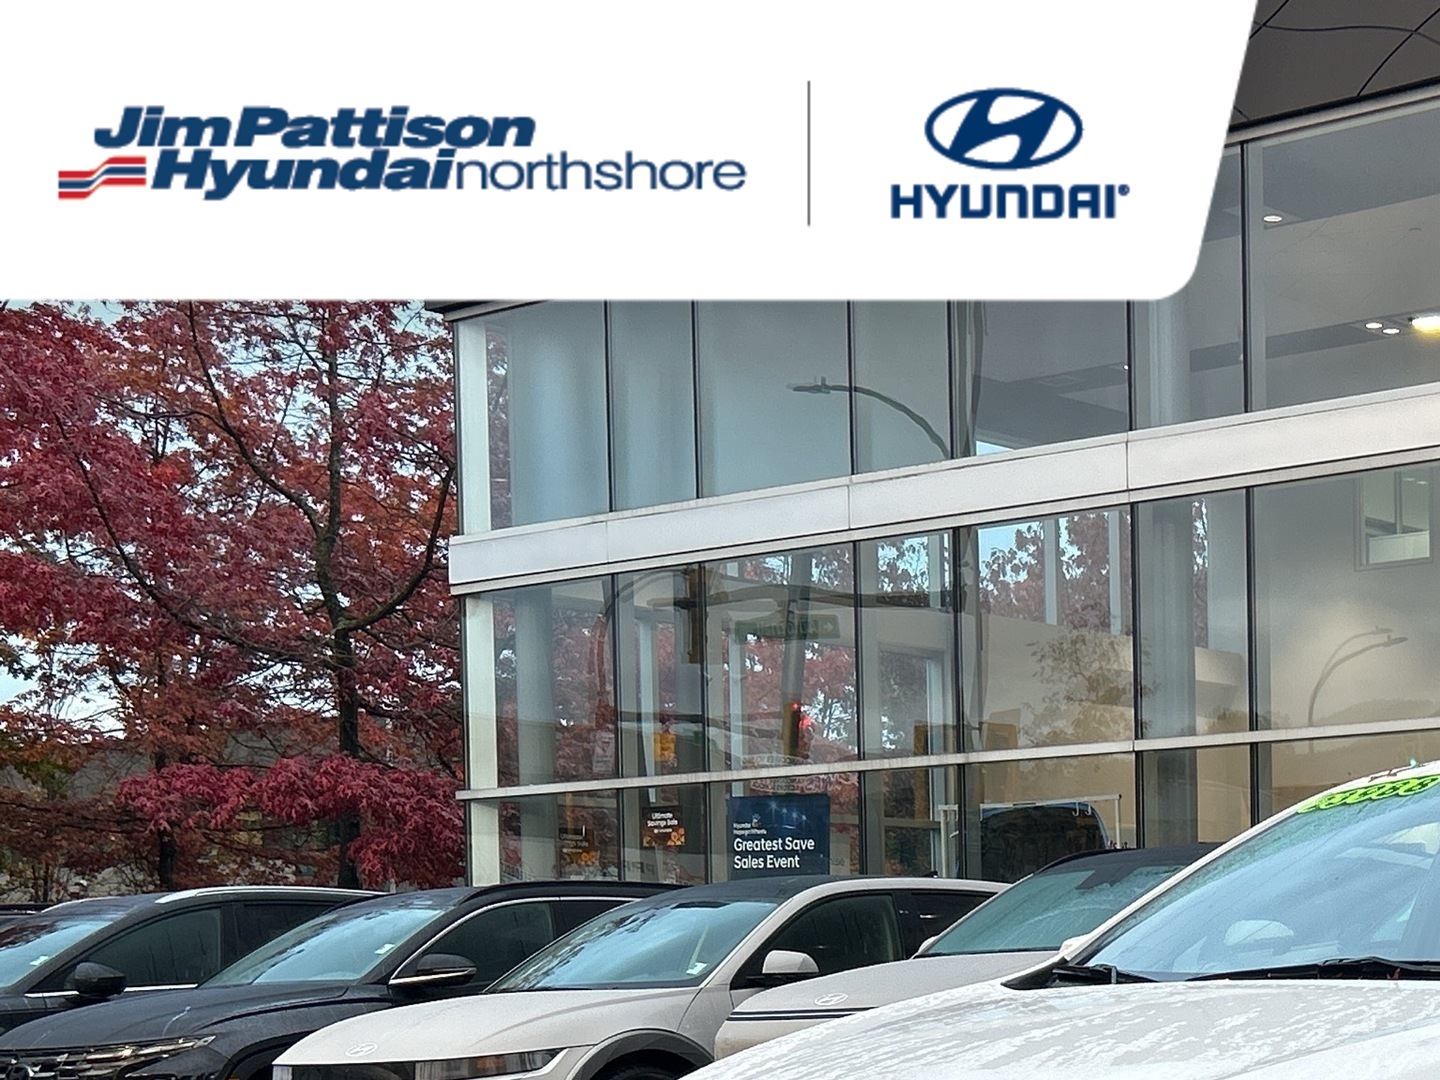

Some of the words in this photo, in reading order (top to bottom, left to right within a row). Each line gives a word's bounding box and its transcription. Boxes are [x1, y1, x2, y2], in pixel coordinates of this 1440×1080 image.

[651, 812, 673, 820] Ultimate
[733, 837, 783, 852] Greatest
[784, 836, 815, 851] Save
[733, 854, 765, 869] Sales
[766, 854, 800, 869] Event
